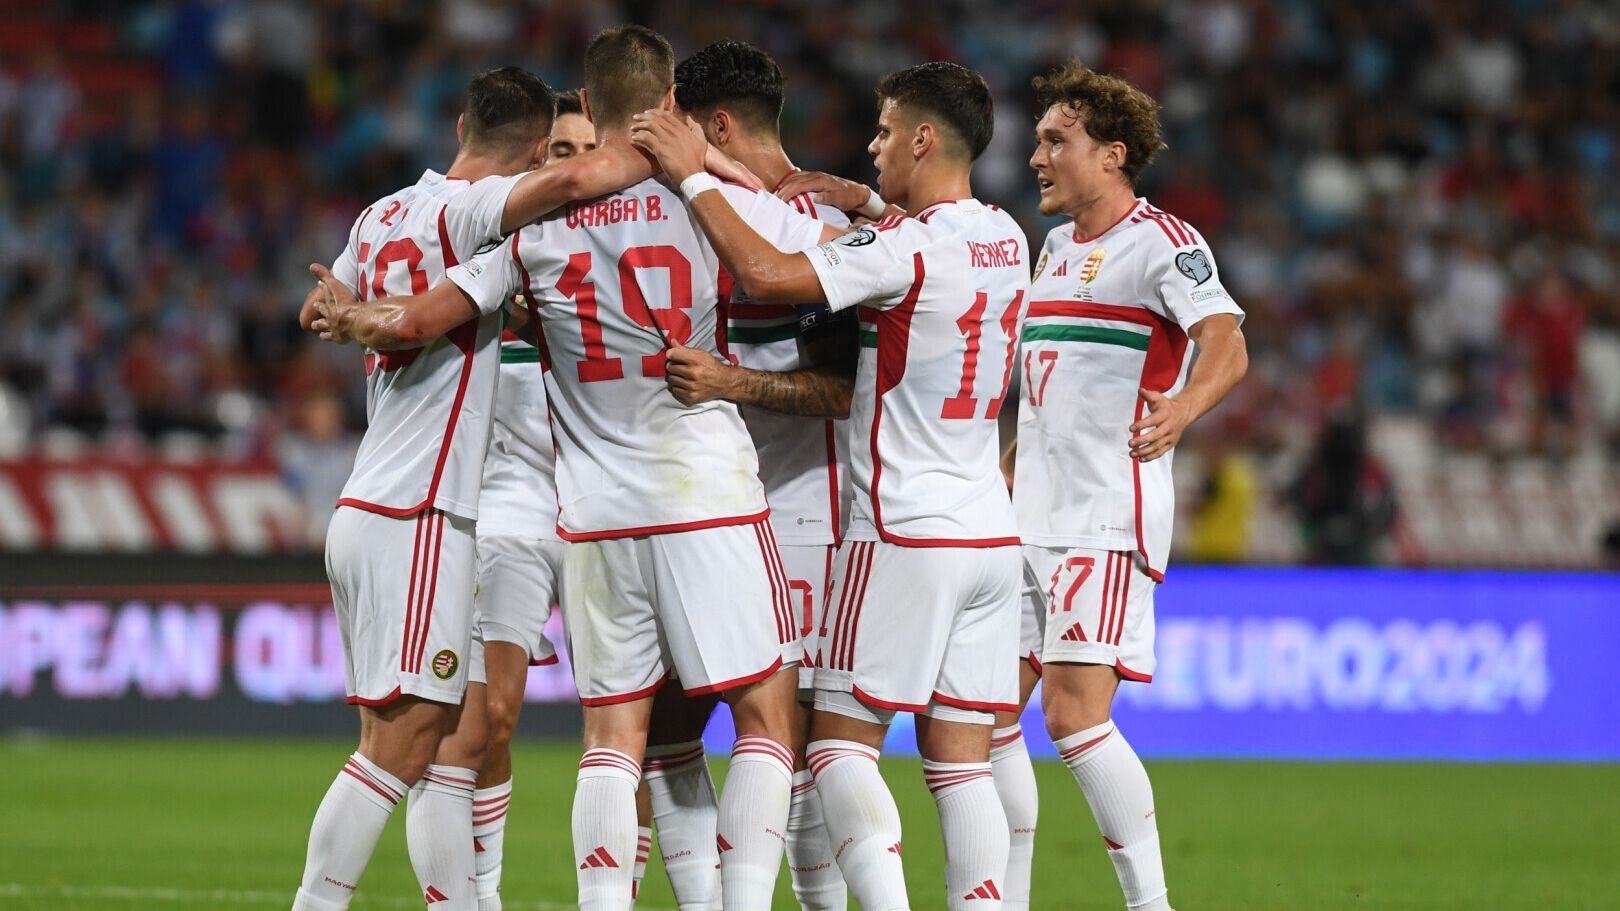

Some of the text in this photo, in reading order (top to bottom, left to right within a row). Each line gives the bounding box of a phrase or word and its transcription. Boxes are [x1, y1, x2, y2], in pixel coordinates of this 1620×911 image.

[566, 194, 669, 230] VARGA B.
[554, 245, 693, 384] 19
[940, 289, 1025, 420] 11
[1024, 350, 1058, 407] 17
[1050, 556, 1095, 615] 17
[0, 602, 221, 699] PEAN
